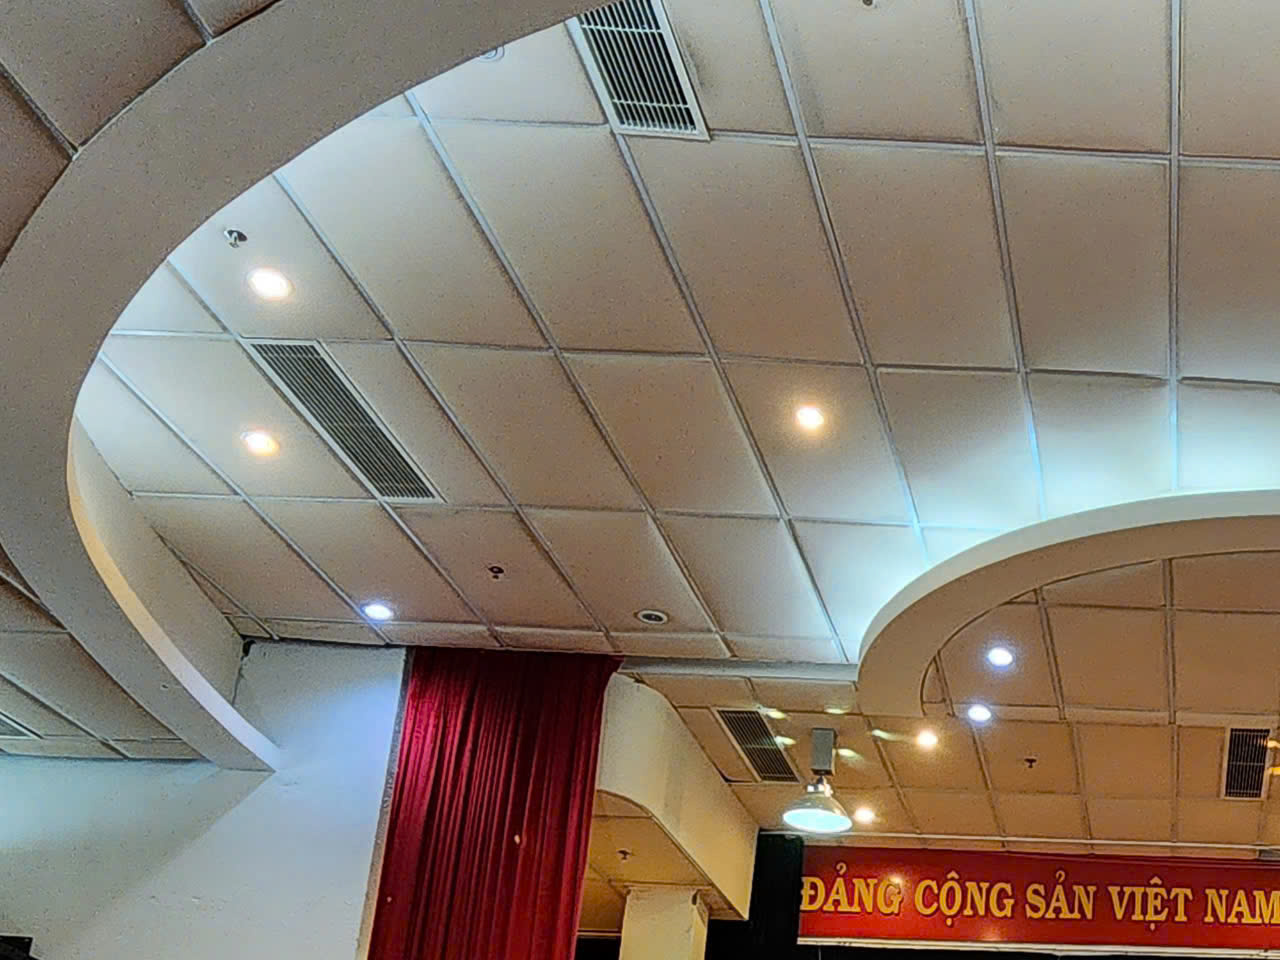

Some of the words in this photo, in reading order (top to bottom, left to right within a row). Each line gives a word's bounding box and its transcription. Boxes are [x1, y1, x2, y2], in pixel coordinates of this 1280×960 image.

[800, 862, 903, 914] ĐẢNG
[914, 870, 1015, 929] CỘNG
[1025, 870, 1096, 920] SẢN
[1107, 876, 1194, 932] VIỆT
